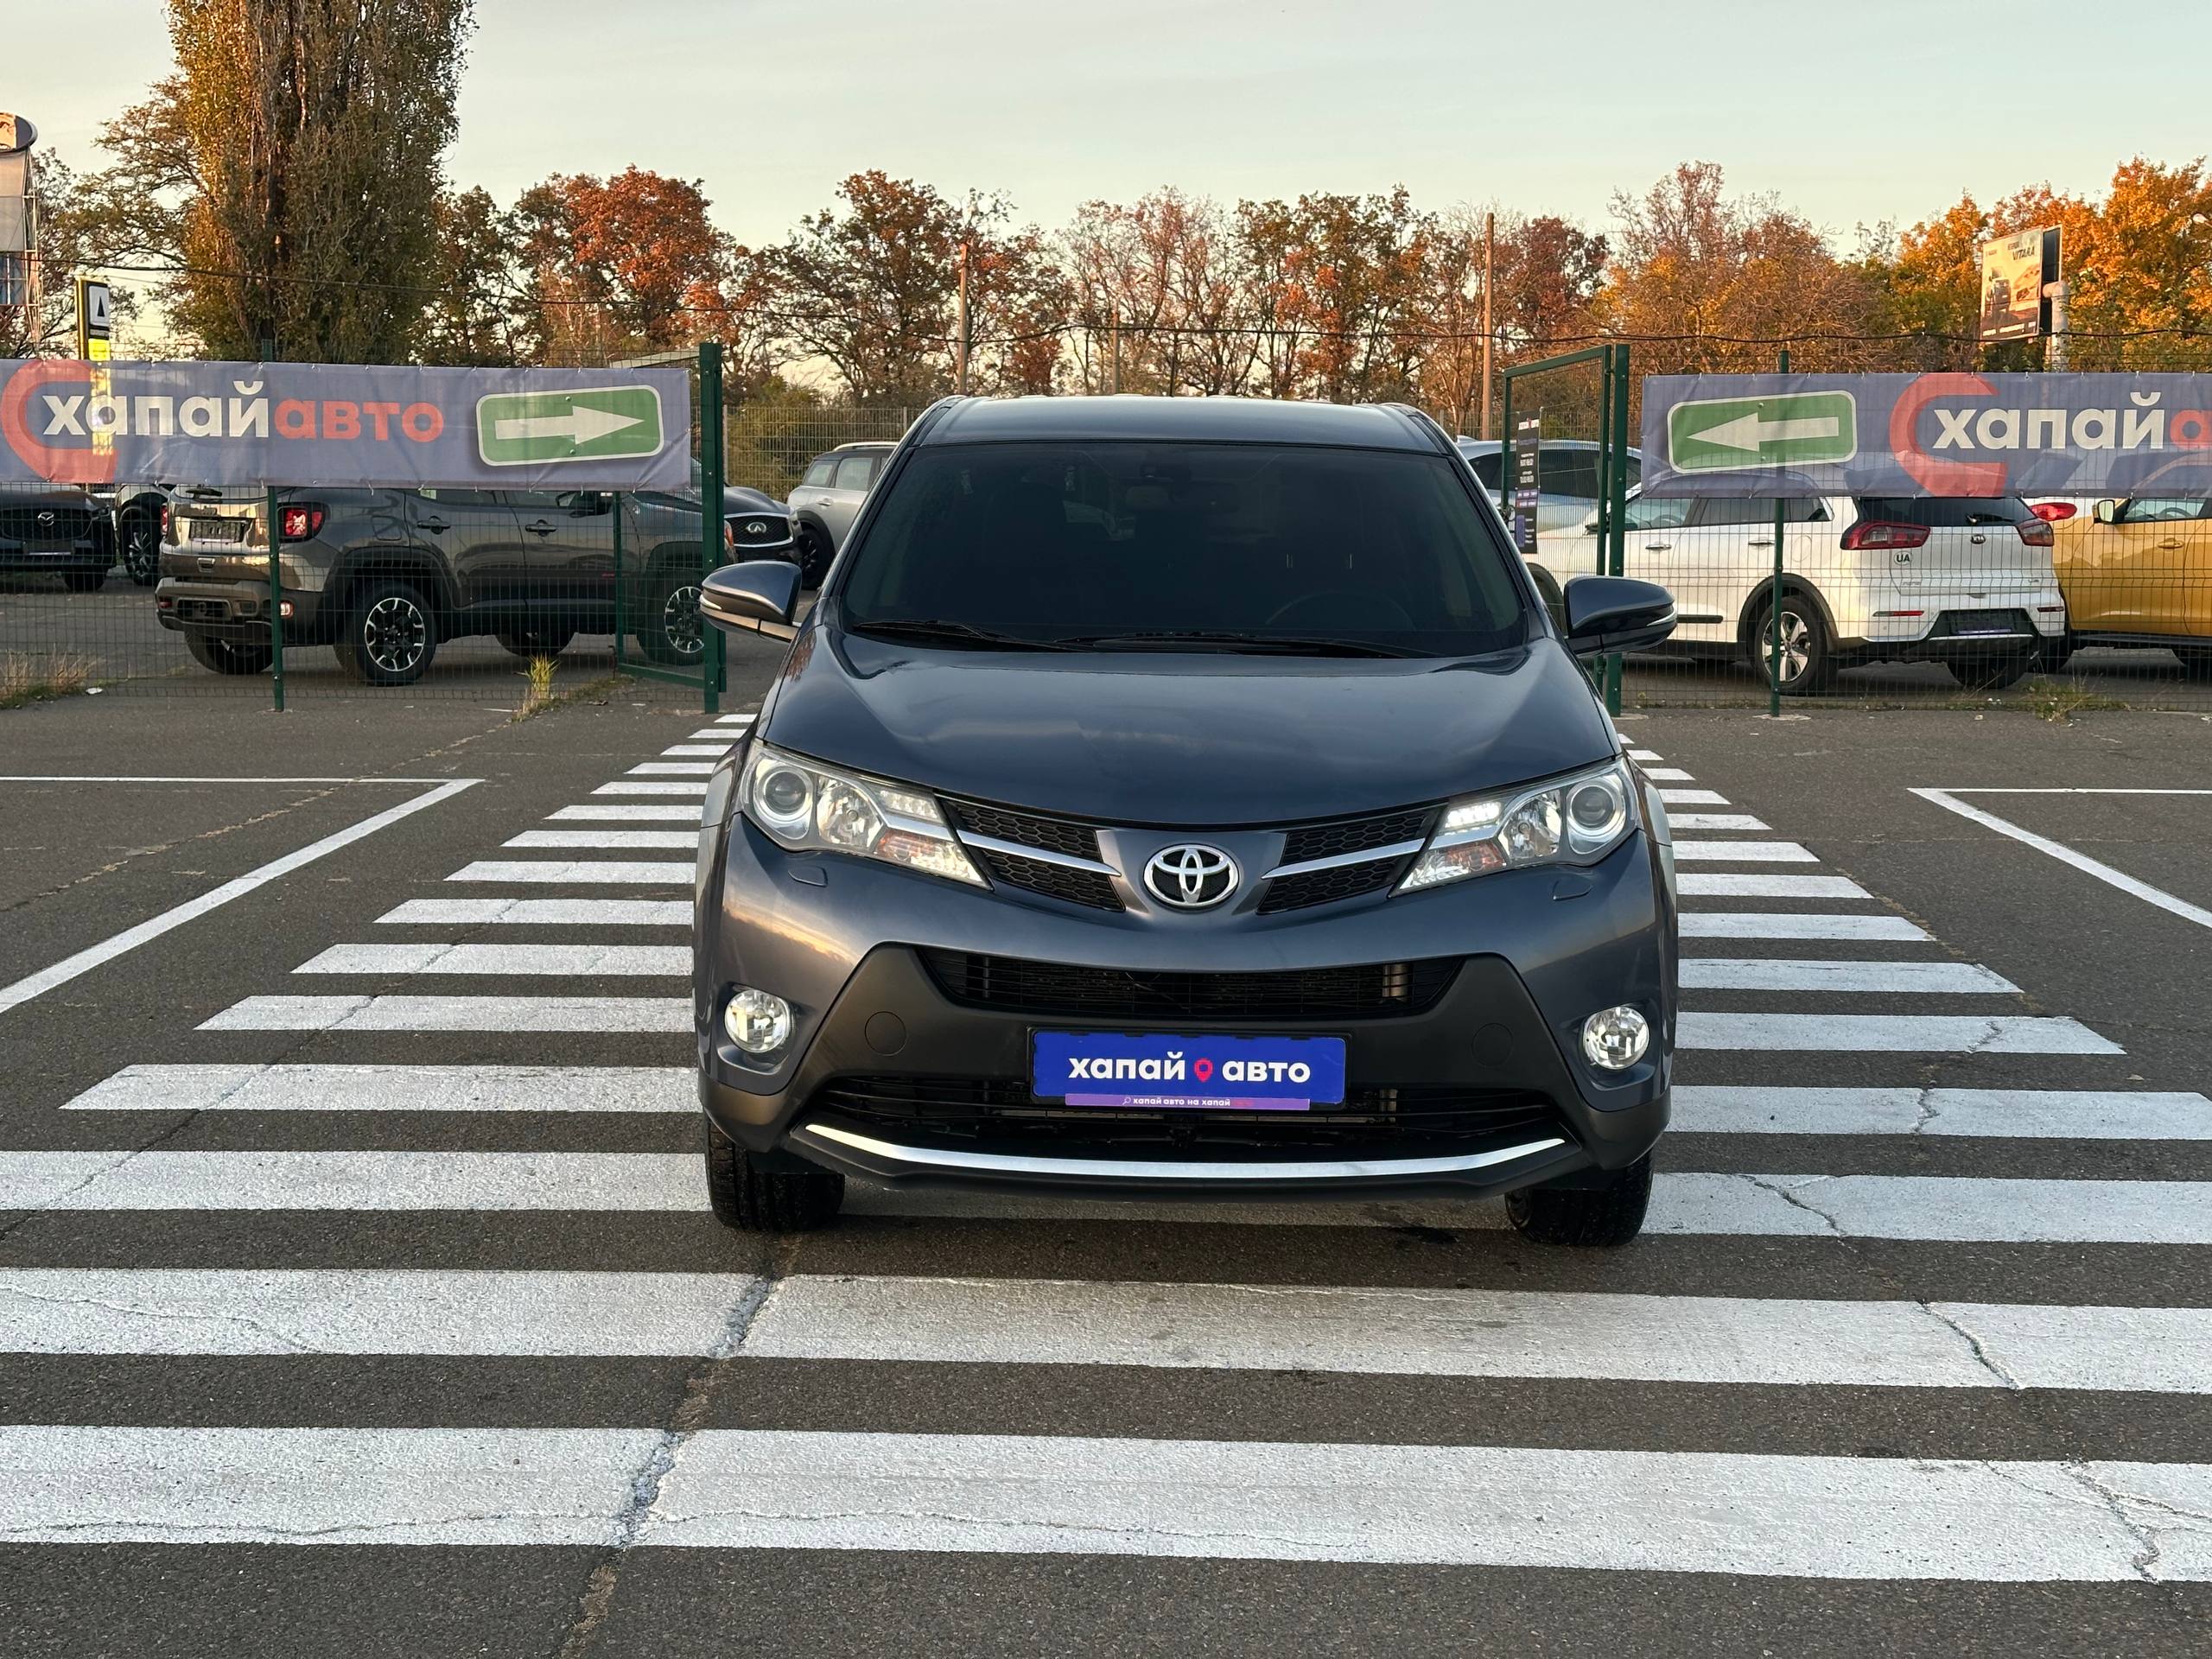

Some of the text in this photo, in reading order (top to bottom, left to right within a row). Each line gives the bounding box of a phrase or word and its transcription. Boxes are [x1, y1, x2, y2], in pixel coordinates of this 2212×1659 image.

[1896, 554, 1910, 563] UA
[1068, 1051, 1311, 1084] хапай авто
[1202, 1098, 1230, 1107] хапай
